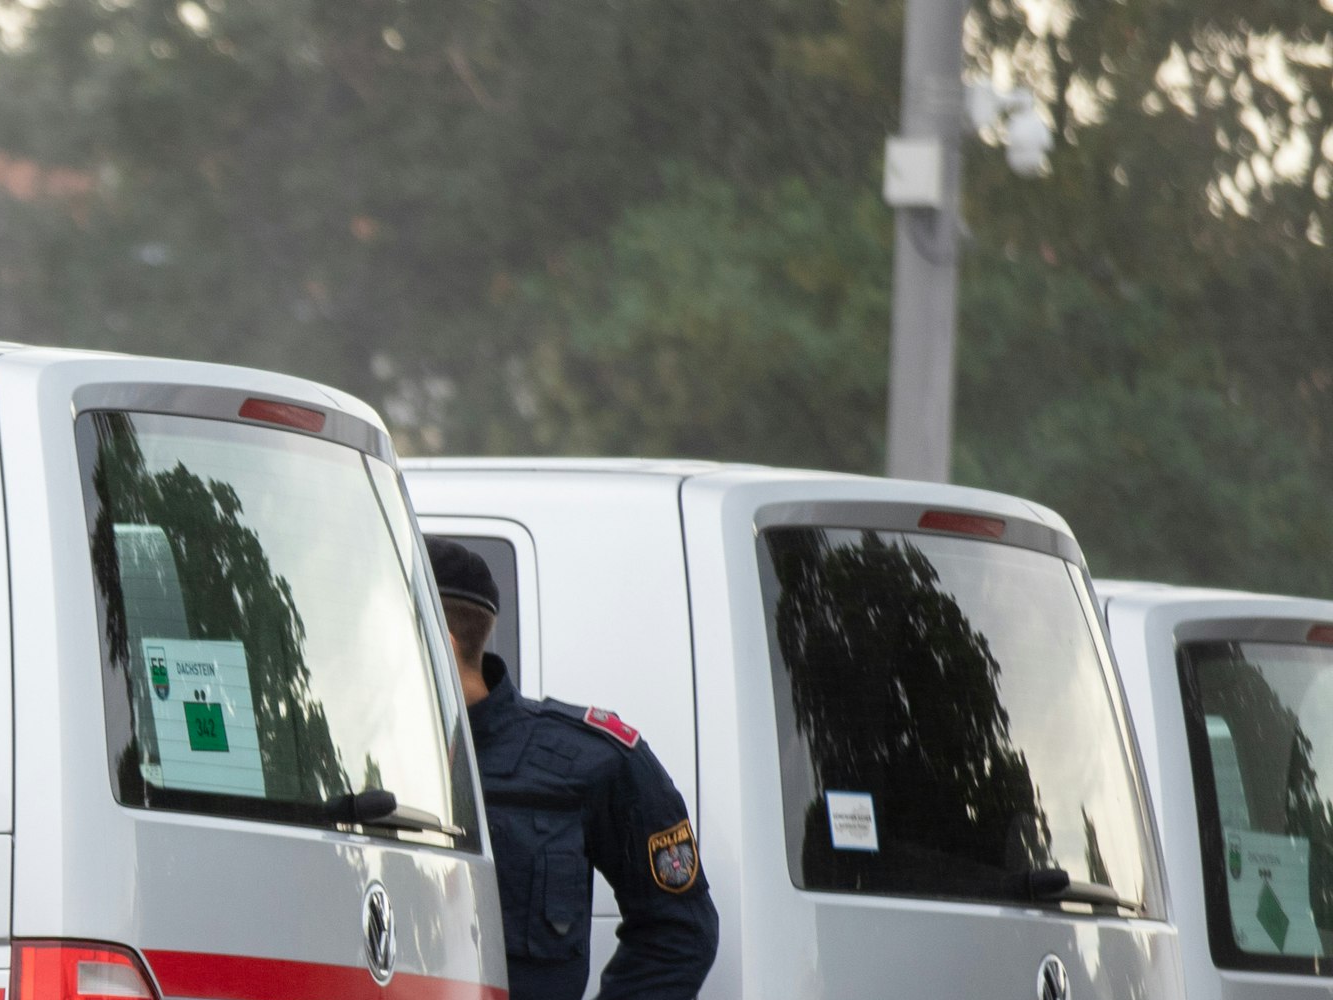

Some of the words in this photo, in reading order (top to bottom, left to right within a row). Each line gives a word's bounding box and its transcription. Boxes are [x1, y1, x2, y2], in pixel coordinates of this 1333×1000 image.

[151, 657, 168, 677] EE
[176, 662, 216, 677] DACHSTEIN
[196, 717, 218, 738] 342
